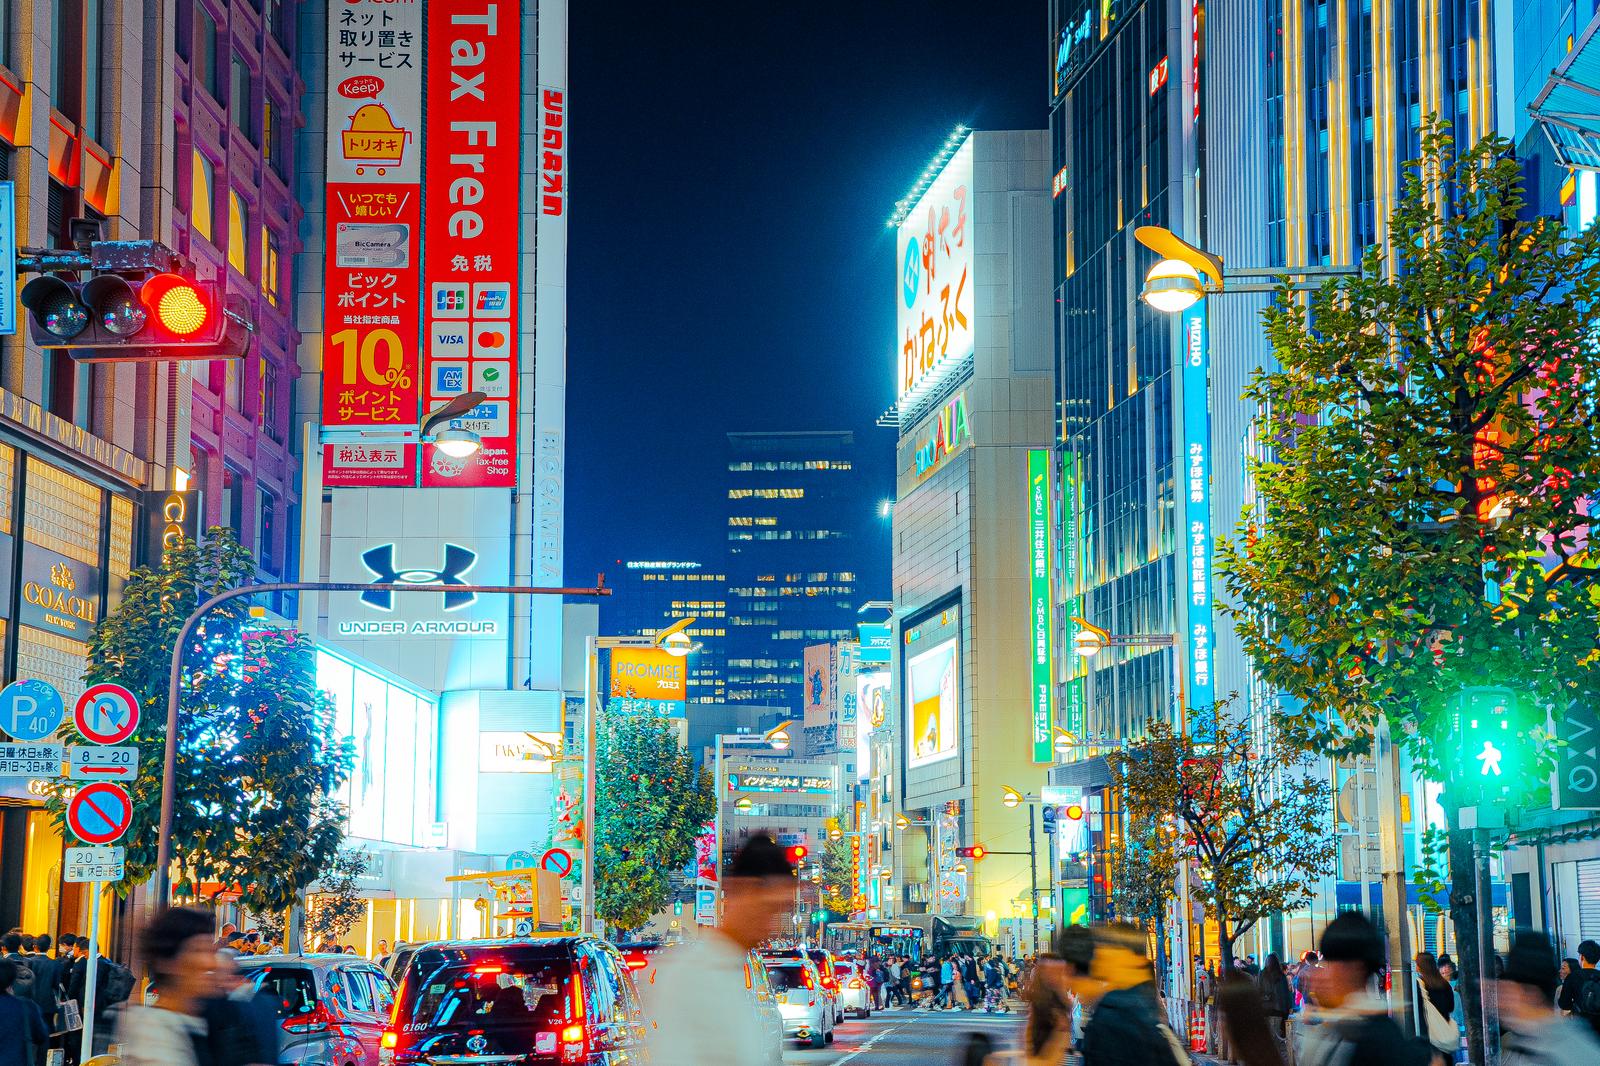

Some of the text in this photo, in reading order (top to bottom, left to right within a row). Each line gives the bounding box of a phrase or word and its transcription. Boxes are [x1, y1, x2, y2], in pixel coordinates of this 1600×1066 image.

[340, 9, 393, 27] ネット
[339, 29, 413, 48] 取り置き
[339, 51, 413, 69] サービス
[343, 80, 380, 95] Keep!
[449, 4, 498, 239] Tax Free
[349, 138, 398, 152] トリオキ
[349, 193, 398, 204] いつでも
[354, 205, 392, 217] 嬉しい
[451, 255, 492, 272] 免税
[347, 273, 398, 289] ビック
[337, 292, 406, 308] ポイント
[343, 315, 400, 325] 当社指定商品
[904, 262, 968, 392] かねふく
[438, 335, 464, 344] VISA
[1190, 317, 1202, 367] MIZUHO
[443, 370, 463, 379] AM
[446, 379, 463, 388] EX
[338, 391, 402, 406] ポイント
[338, 406, 402, 422] サービス
[465, 421, 490, 430] 支付宝
[339, 449, 398, 463] 税込表示
[479, 448, 509, 456] Japan.
[476, 457, 509, 465] Tax-free
[487, 466, 509, 476] Shop
[1035, 486, 1043, 516] SMBC
[1034, 520, 1046, 578] 三井住友銀行
[24, 581, 95, 624] COACH
[339, 620, 497, 635] UNDER ARMOUR
[617, 662, 681, 680] PROMISE
[656, 680, 680, 689] プロミス
[12, 695, 38, 733] P
[658, 702, 676, 715] 6F
[29, 716, 48, 733] 40
[82, 751, 90, 763] 8
[111, 751, 130, 763] 20
[76, 852, 93, 864] 20
[402, 1022, 428, 1032] 6160
